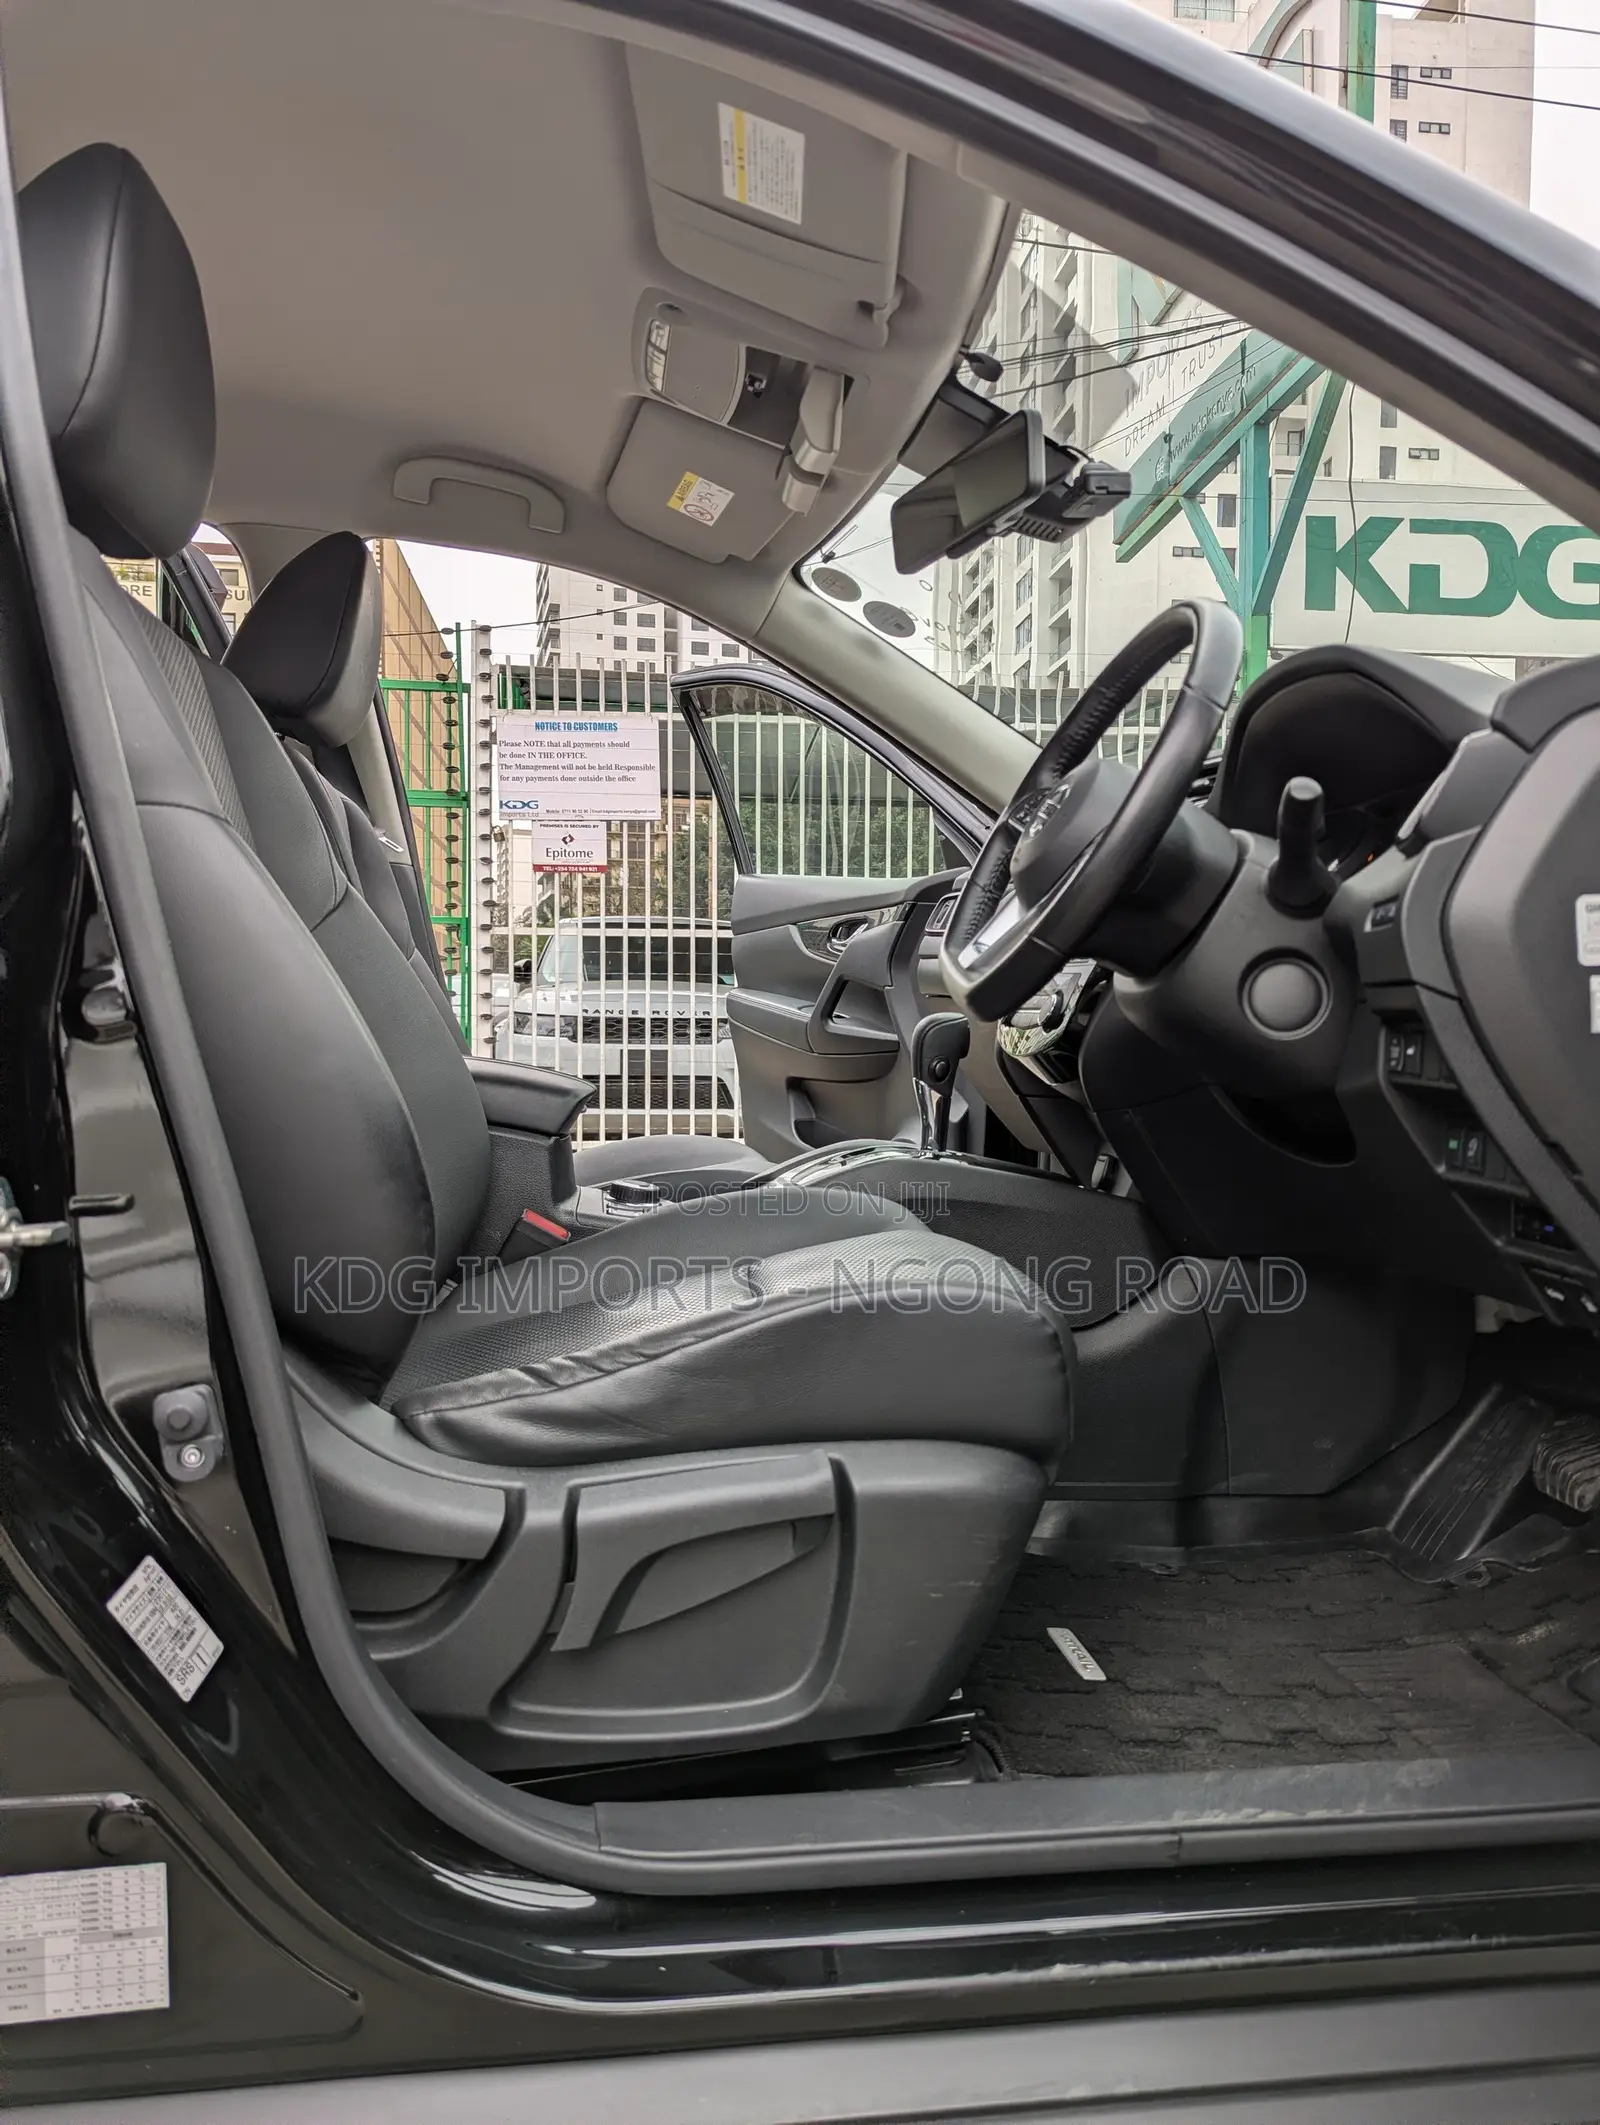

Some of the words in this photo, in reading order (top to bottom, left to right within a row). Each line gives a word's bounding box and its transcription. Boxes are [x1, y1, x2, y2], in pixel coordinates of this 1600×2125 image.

[1124, 299, 1203, 418] IMPORTS
[1124, 395, 1166, 458] DREAM
[1181, 324, 1224, 390] TRUST
[1304, 515, 1600, 620] KDG
[225, 589, 251, 601] SU
[535, 721, 561, 731] NOTICE
[562, 722, 572, 731] TO
[573, 722, 618, 732] CUSTOMERS
[499, 740, 522, 748] Please
[523, 740, 545, 748] NOTE
[547, 740, 561, 748] that
[562, 740, 572, 748] all
[572, 741, 606, 750] payments
[607, 740, 630, 748] should
[556, 752, 588, 760] OFFICE.
[514, 763, 560, 772] Management
[561, 763, 574, 771] will
[614, 764, 656, 772] Responsible
[525, 775, 559, 783] payments
[499, 800, 539, 810] KDG
[546, 848, 594, 860] Epitome
[175, 1660, 195, 1686] SRS
